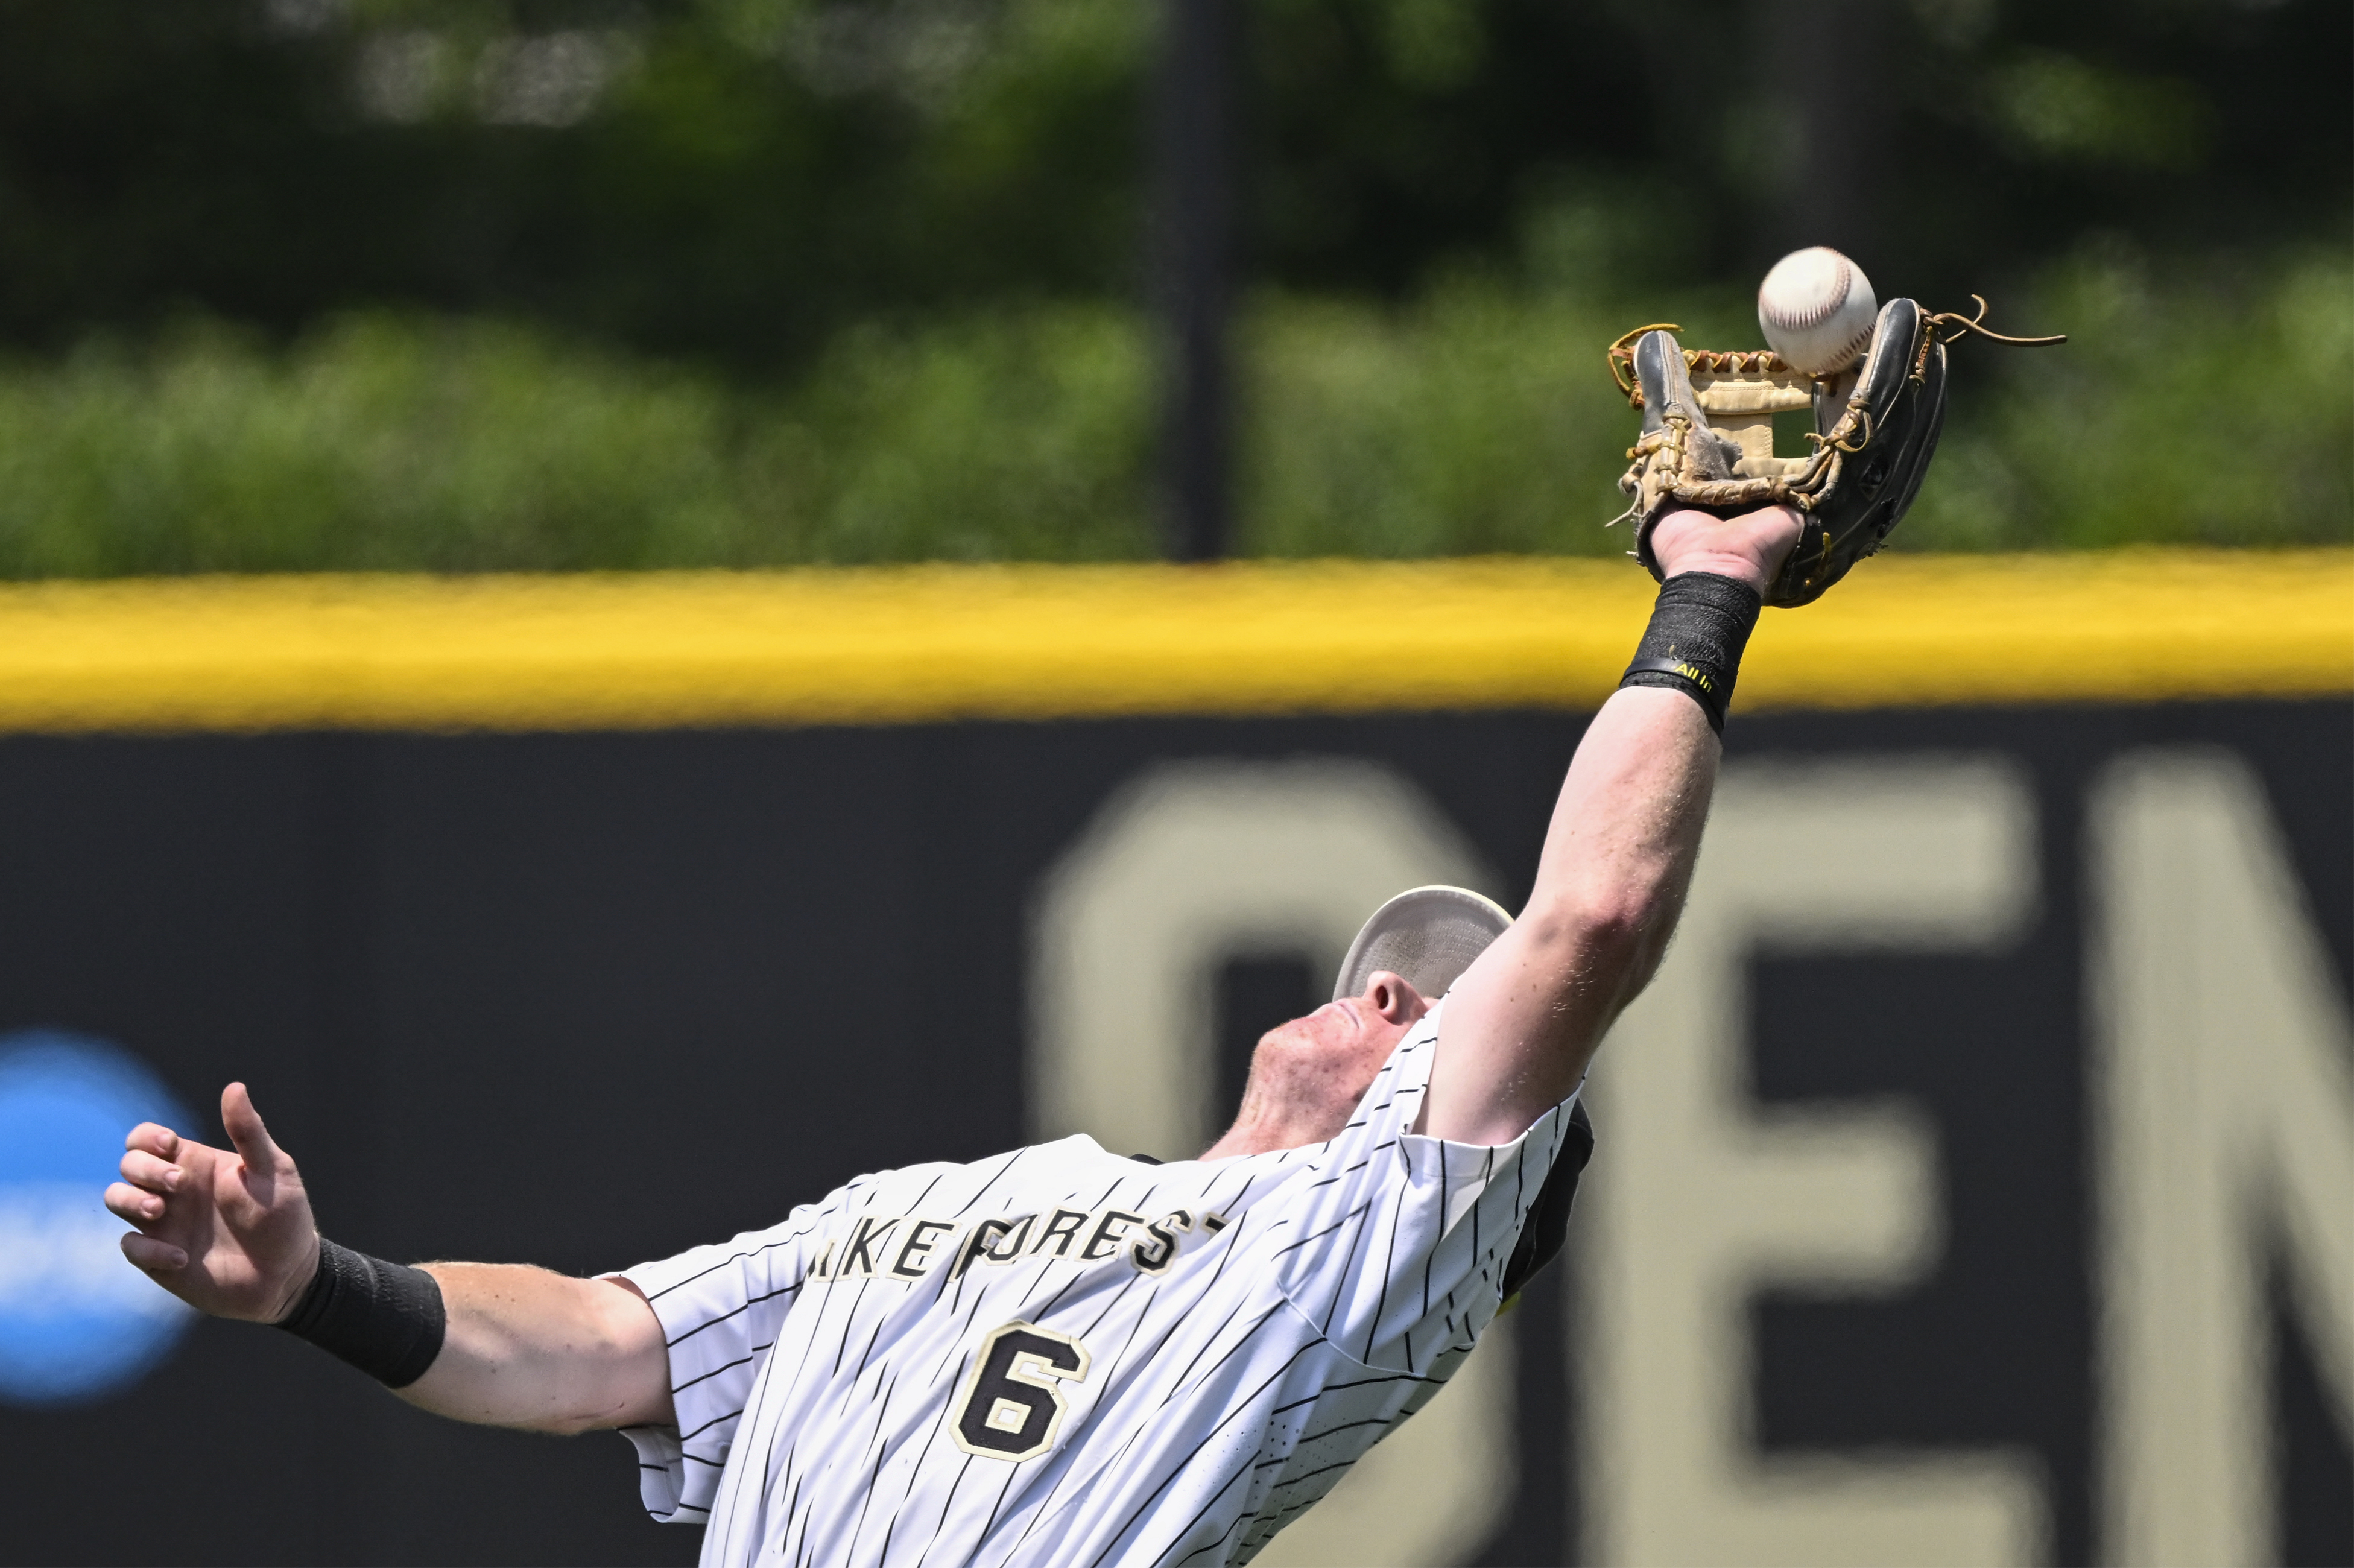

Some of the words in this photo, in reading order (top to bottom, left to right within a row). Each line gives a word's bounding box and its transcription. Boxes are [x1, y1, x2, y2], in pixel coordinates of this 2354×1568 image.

[1674, 663, 1700, 680] All
[1698, 674, 1712, 693] In
[947, 1205, 1230, 1283] FORES
[948, 1319, 1092, 1462] 6
